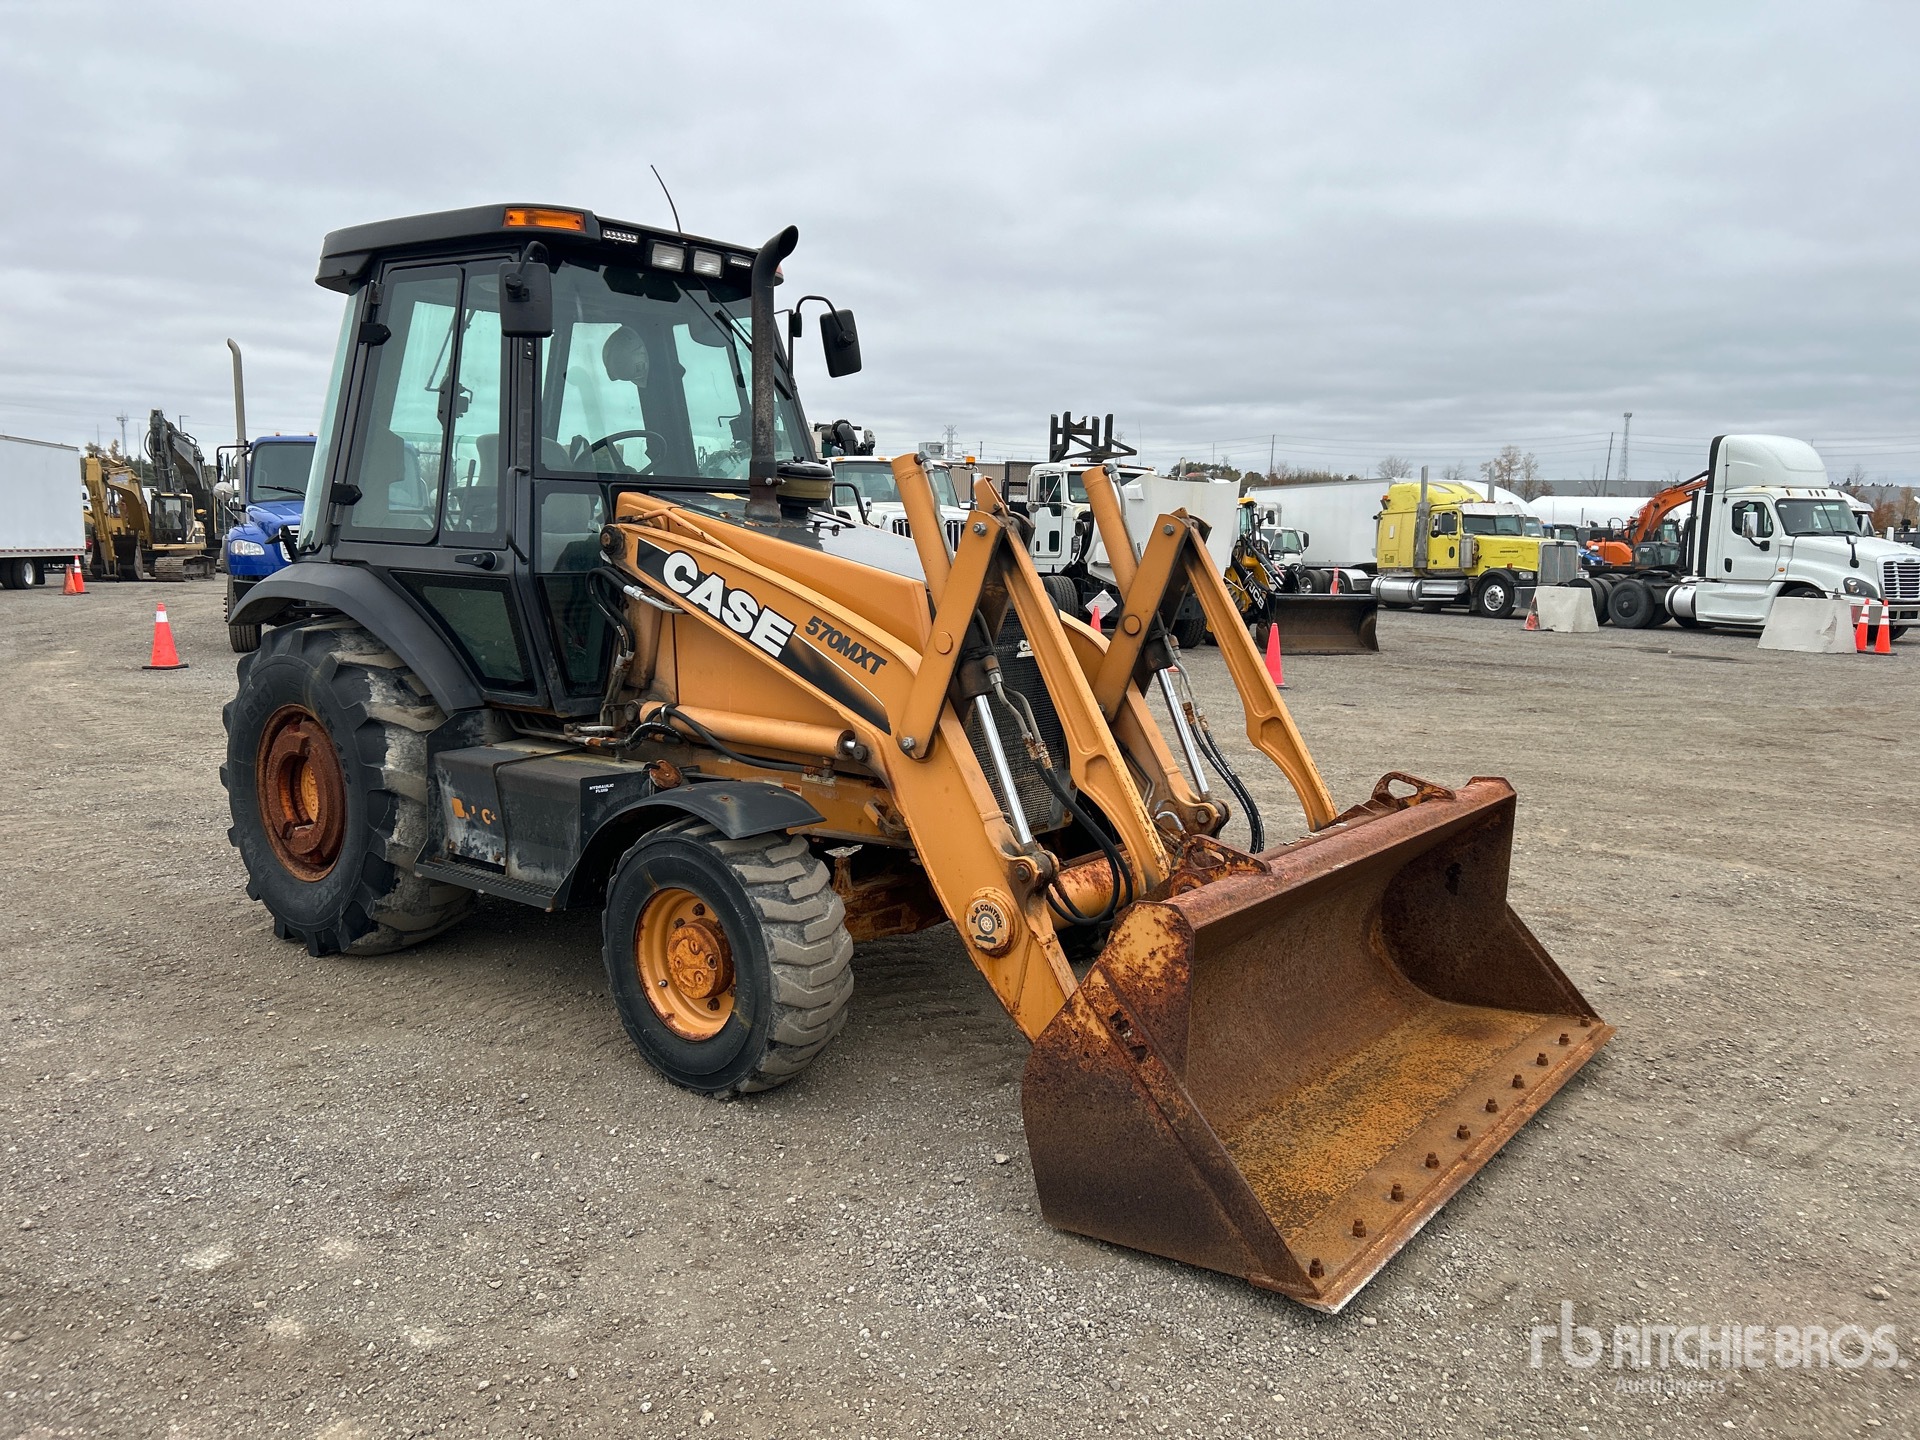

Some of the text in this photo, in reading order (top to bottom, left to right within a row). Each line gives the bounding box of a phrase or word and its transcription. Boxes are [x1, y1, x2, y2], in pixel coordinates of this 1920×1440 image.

[663, 551, 796, 657] CASE
[1249, 580, 1265, 610] JCB
[805, 616, 888, 676] 570MXT
[980, 904, 1003, 930] CONTROL
